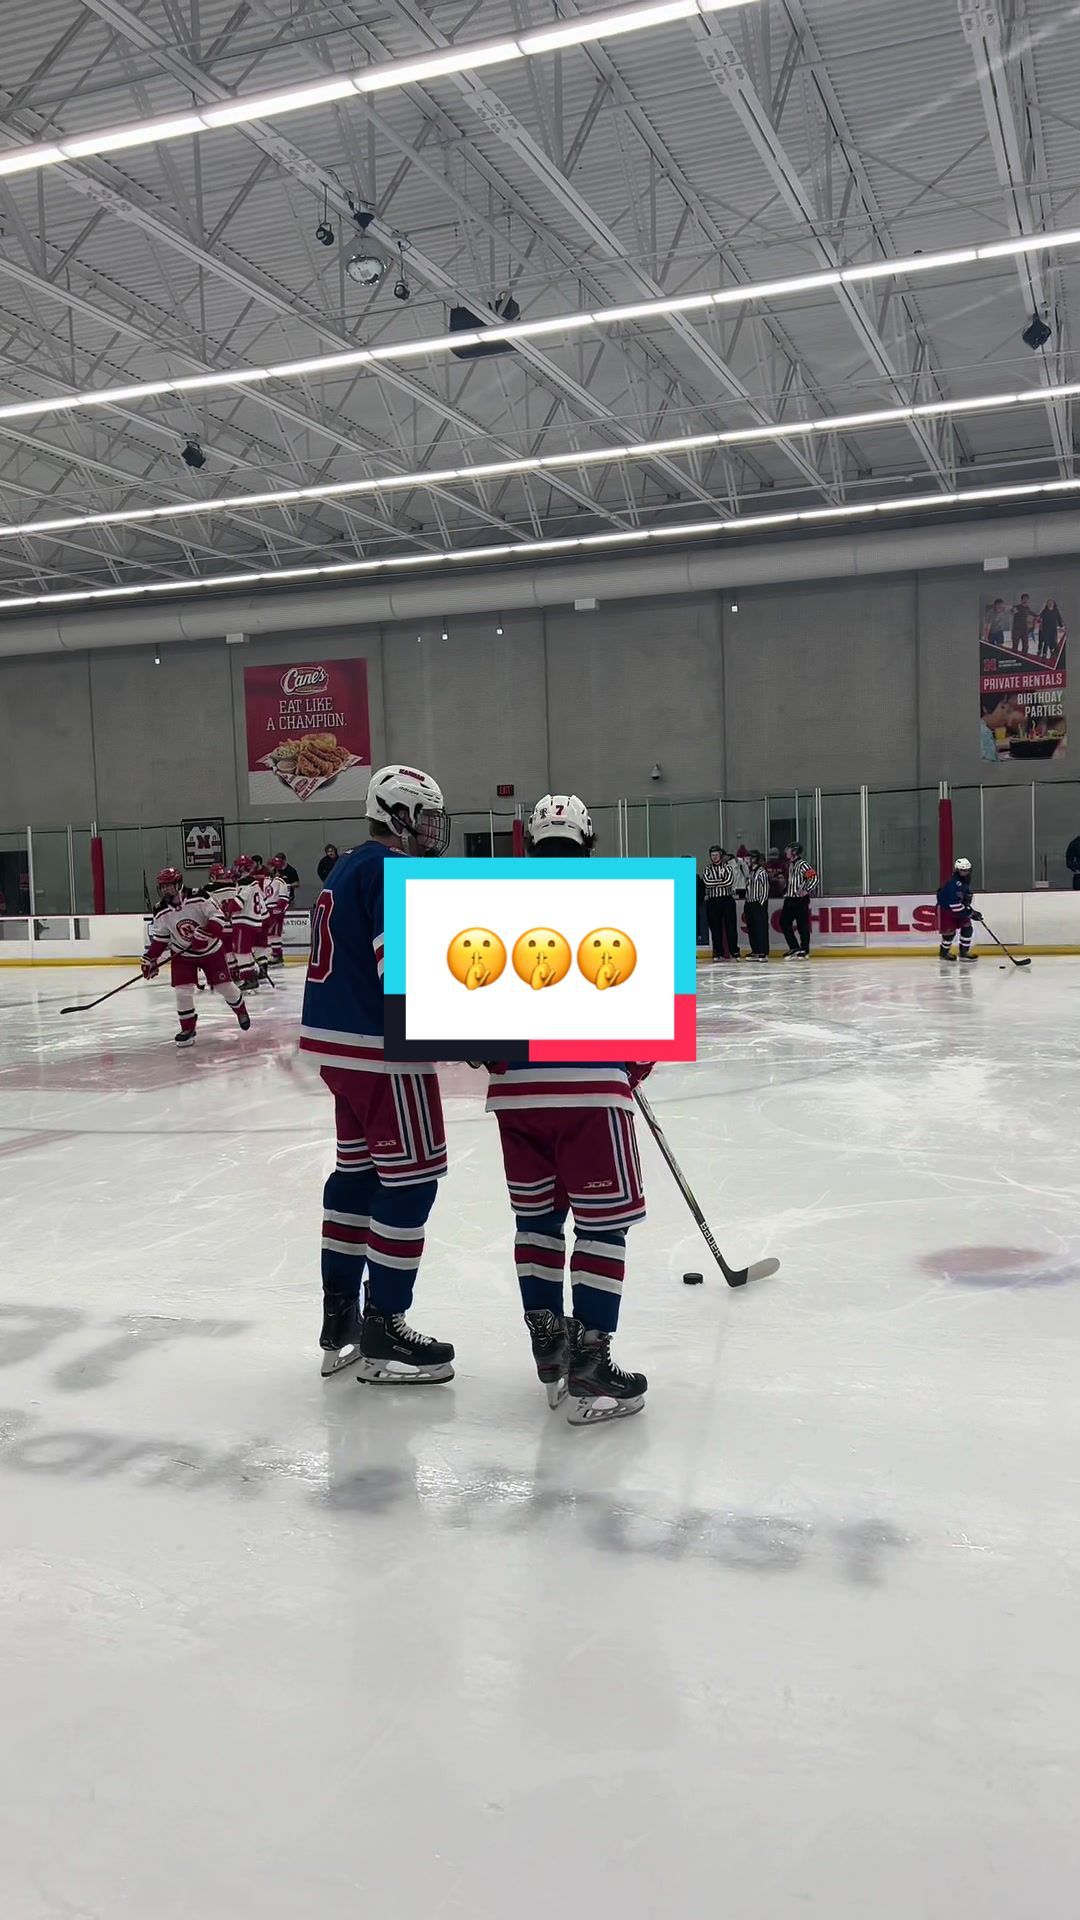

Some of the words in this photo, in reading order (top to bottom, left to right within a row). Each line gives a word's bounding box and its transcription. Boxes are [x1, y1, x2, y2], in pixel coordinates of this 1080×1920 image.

[984, 677, 1020, 691] PRIVATE
[1022, 673, 1063, 688] RENTALS
[1017, 690, 1063, 705] BIRTHDAY
[279, 700, 303, 714] EAT
[305, 697, 333, 712] LIKE
[1024, 704, 1063, 718] PARTIES
[266, 717, 276, 731] A
[279, 712, 347, 730] CHAMPION.
[499, 785, 511, 794] EXIT
[555, 805, 564, 815] 7
[196, 835, 211, 849] N
[741, 905, 940, 934] HEELS
